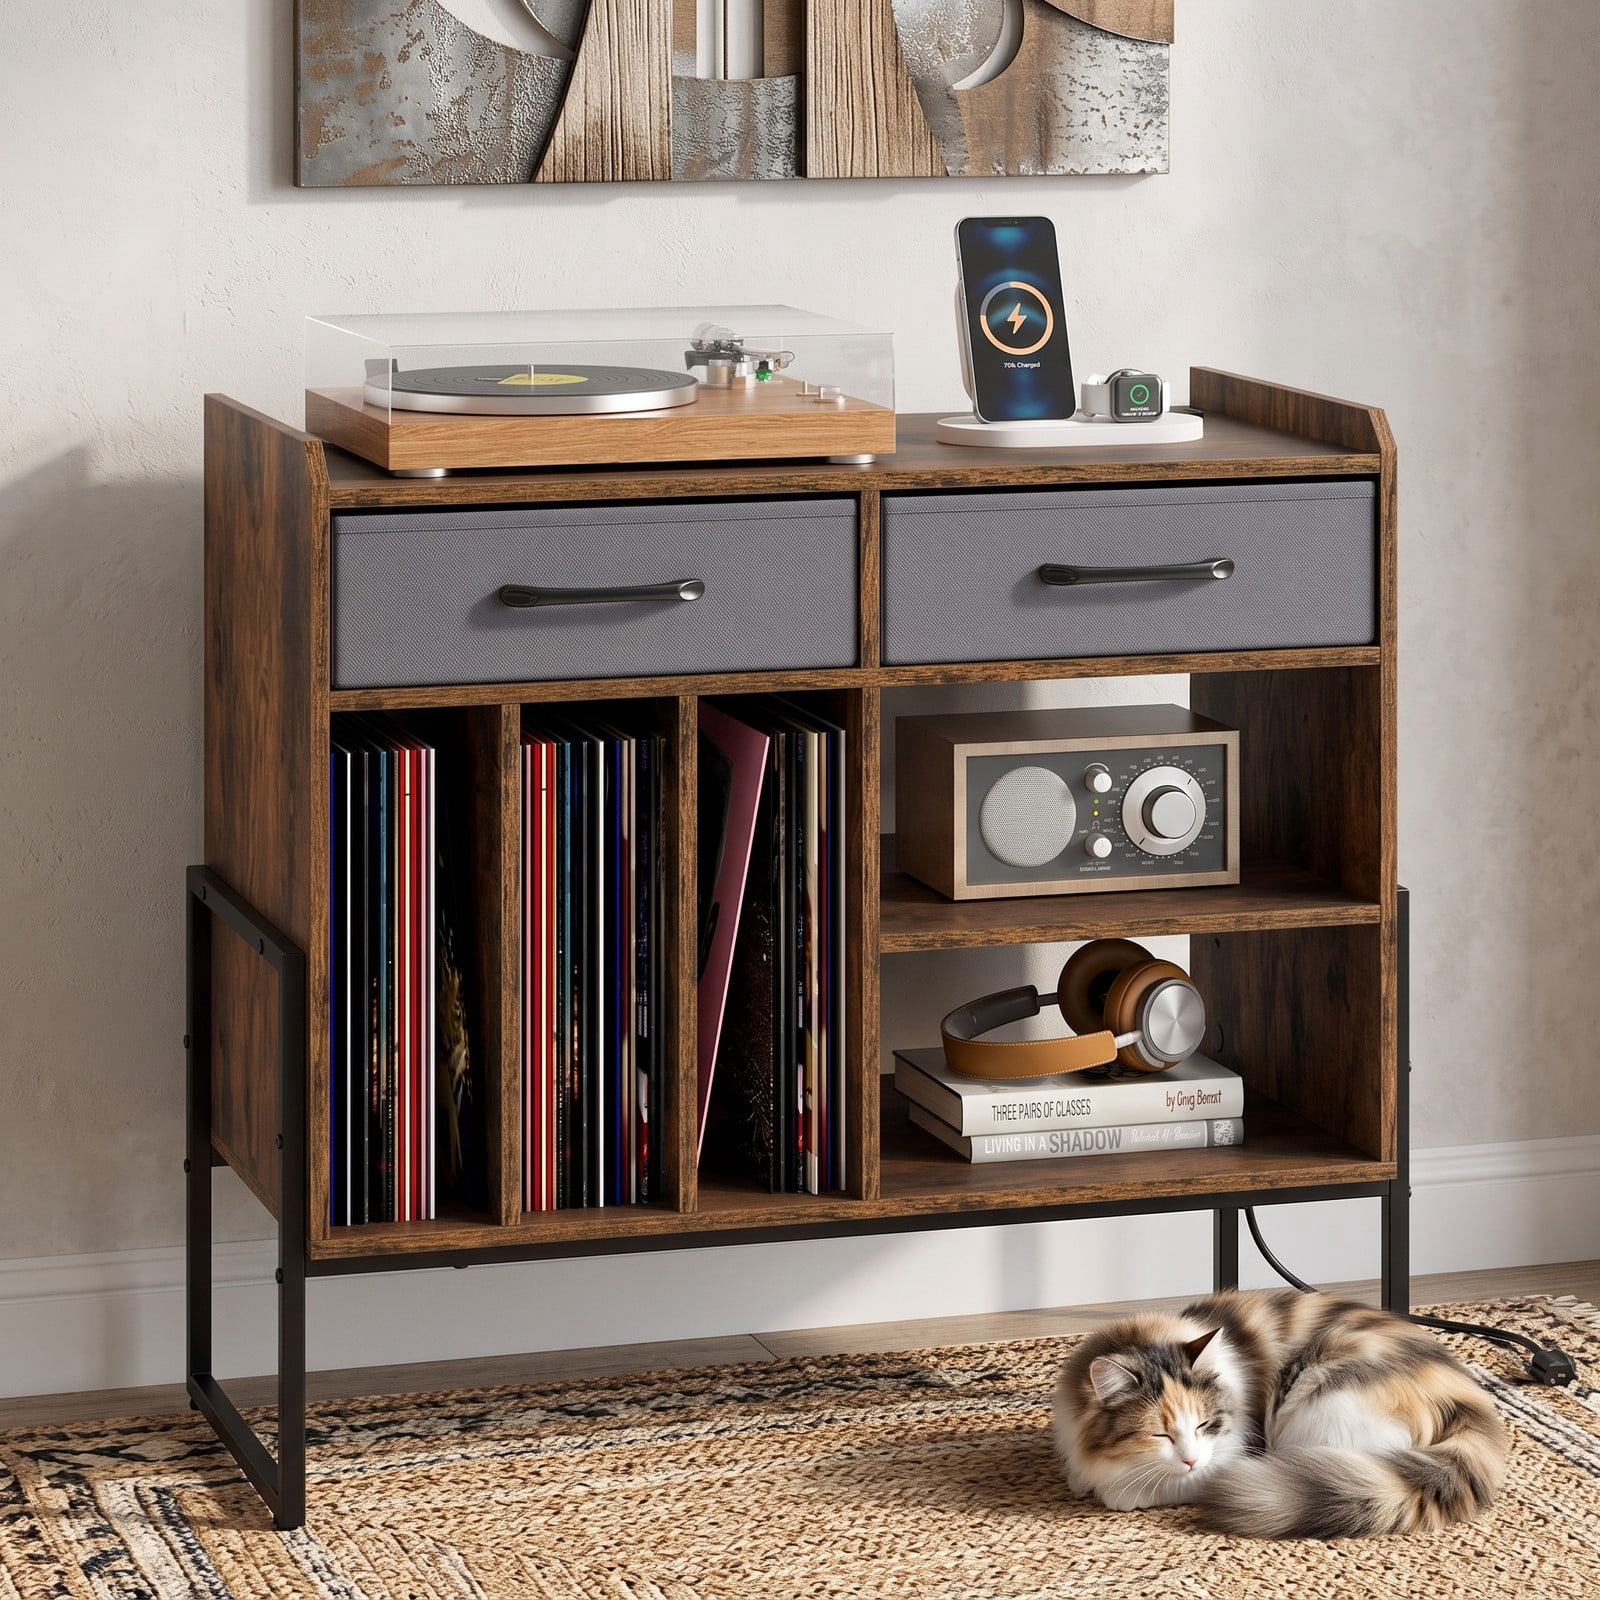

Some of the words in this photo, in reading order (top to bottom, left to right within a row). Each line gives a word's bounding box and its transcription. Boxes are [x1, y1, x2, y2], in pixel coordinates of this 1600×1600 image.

[1016, 361, 1041, 369] Charged
[992, 1103, 1017, 1121] THREE
[1019, 1102, 1042, 1119] PAIRS
[1043, 1101, 1054, 1118] OF
[1166, 1090, 1176, 1112] by
[984, 1137, 1021, 1154] LIVING
[1024, 1136, 1035, 1151] IN
[1038, 1135, 1047, 1150] A
[1049, 1128, 1122, 1153] SHADOW
